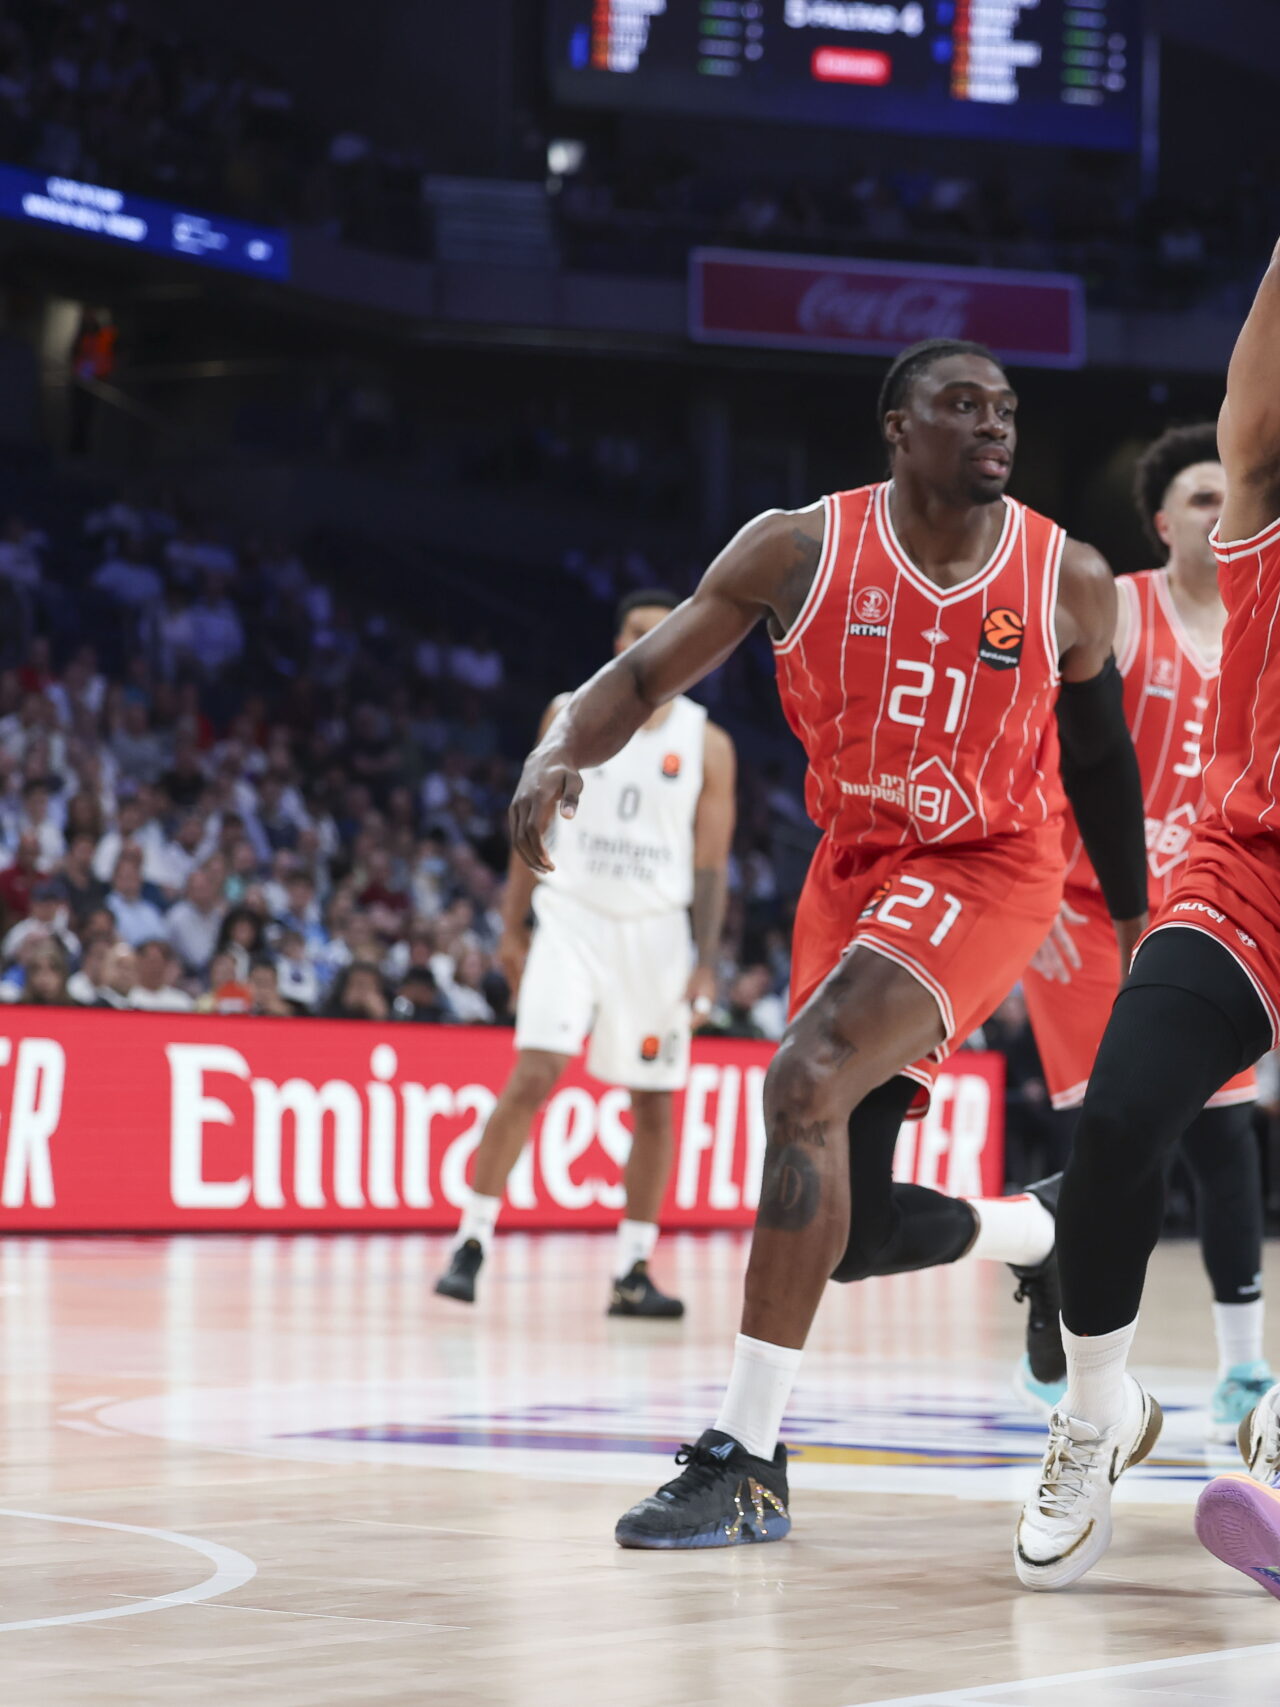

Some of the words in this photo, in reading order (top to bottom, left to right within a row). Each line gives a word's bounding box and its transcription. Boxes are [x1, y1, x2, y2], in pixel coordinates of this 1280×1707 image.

[849, 623, 887, 637] RTMI
[887, 658, 967, 734] 21
[617, 782, 641, 823] 0
[908, 783, 951, 825] IBI
[876, 875, 962, 948] 21
[1172, 902, 1227, 924] nuvei
